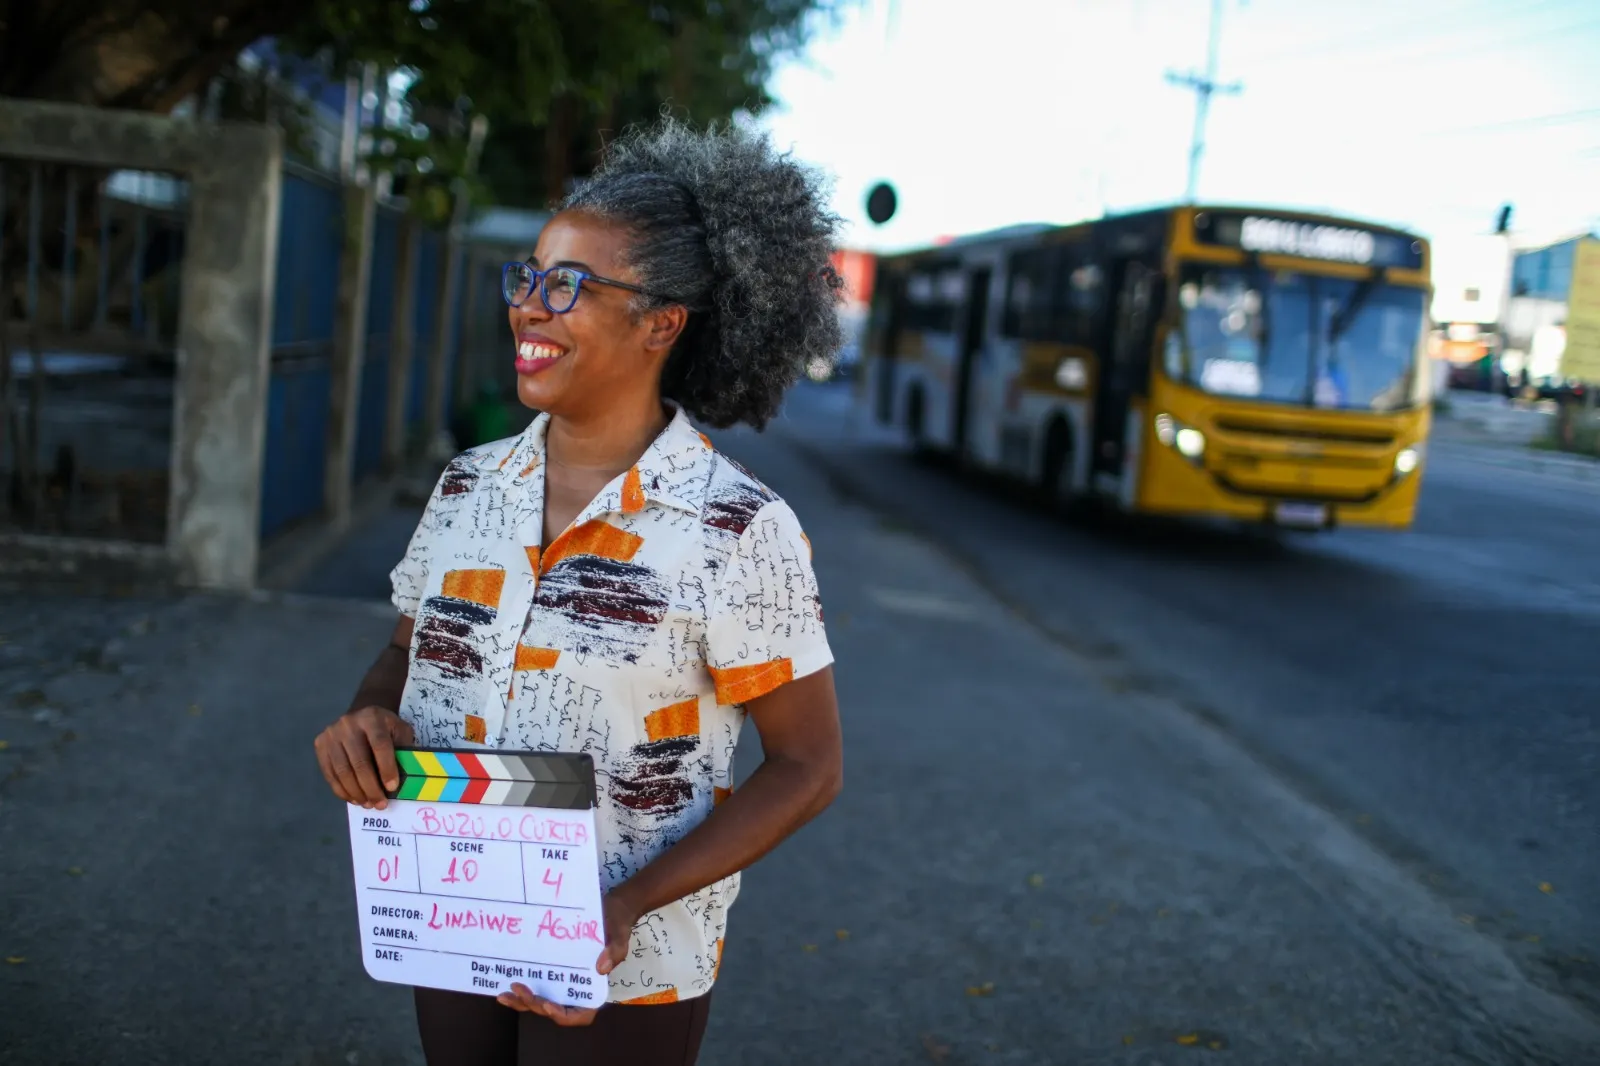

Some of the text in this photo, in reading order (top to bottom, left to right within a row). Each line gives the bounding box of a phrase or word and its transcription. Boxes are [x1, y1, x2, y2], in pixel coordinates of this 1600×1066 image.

[363, 817, 392, 829] PROD.
[378, 835, 402, 847] ROLL
[450, 841, 484, 854] SCENE
[541, 848, 569, 861] TAKE
[378, 855, 399, 882] 01
[441, 857, 478, 884] 10
[542, 868, 563, 899] 4
[371, 905, 424, 920] DIRECTOR:
[373, 926, 418, 942] CAMERA:
[375, 949, 403, 962] DATE:
[473, 976, 500, 989] Filter
[528, 968, 543, 980] Int
[548, 971, 565, 982] Ext
[570, 973, 592, 986] Mos
[567, 987, 593, 1000] Sync
